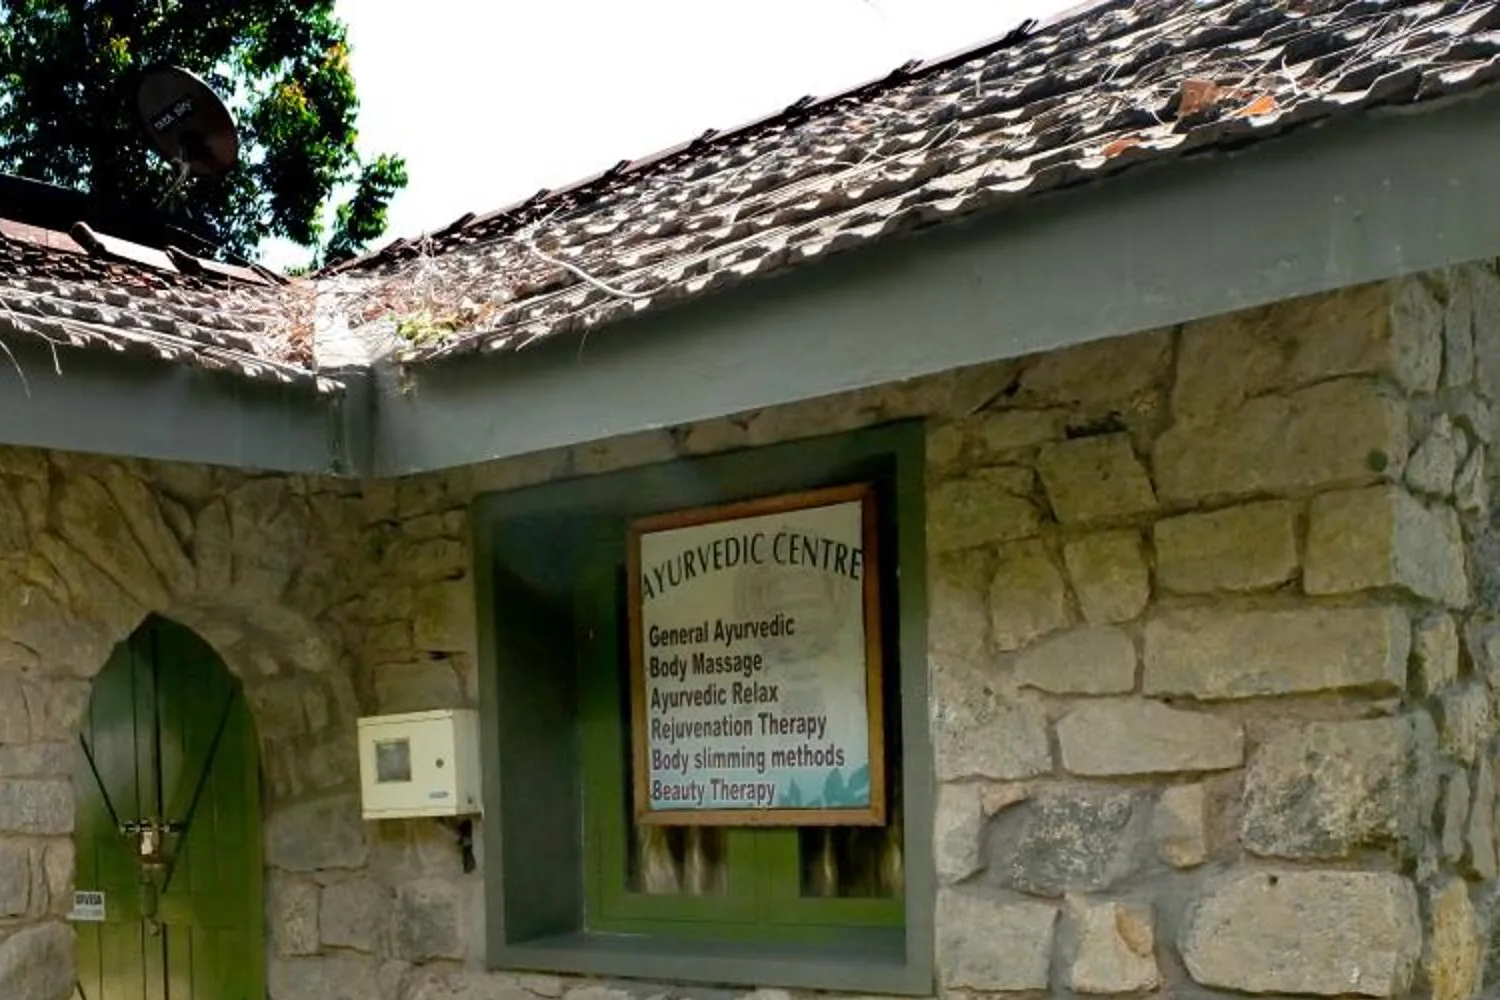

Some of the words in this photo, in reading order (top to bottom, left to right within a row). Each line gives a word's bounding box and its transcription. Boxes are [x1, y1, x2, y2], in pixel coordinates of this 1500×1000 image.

[642, 533, 765, 600] AYURVEDIC
[772, 532, 863, 581] CENTRE
[649, 620, 709, 648] General
[714, 613, 795, 648] Ayurvedic
[650, 654, 687, 682] Body
[692, 647, 763, 678] Massage
[651, 682, 727, 714] Ayurvedic
[732, 680, 779, 705] Relax
[651, 713, 753, 745] Rejuvenation
[757, 711, 827, 740] Therapy
[653, 747, 689, 775] Body
[694, 745, 766, 775] slimming
[771, 743, 846, 767] methods
[653, 778, 705, 806] Beauty
[710, 777, 776, 806] Therapy
